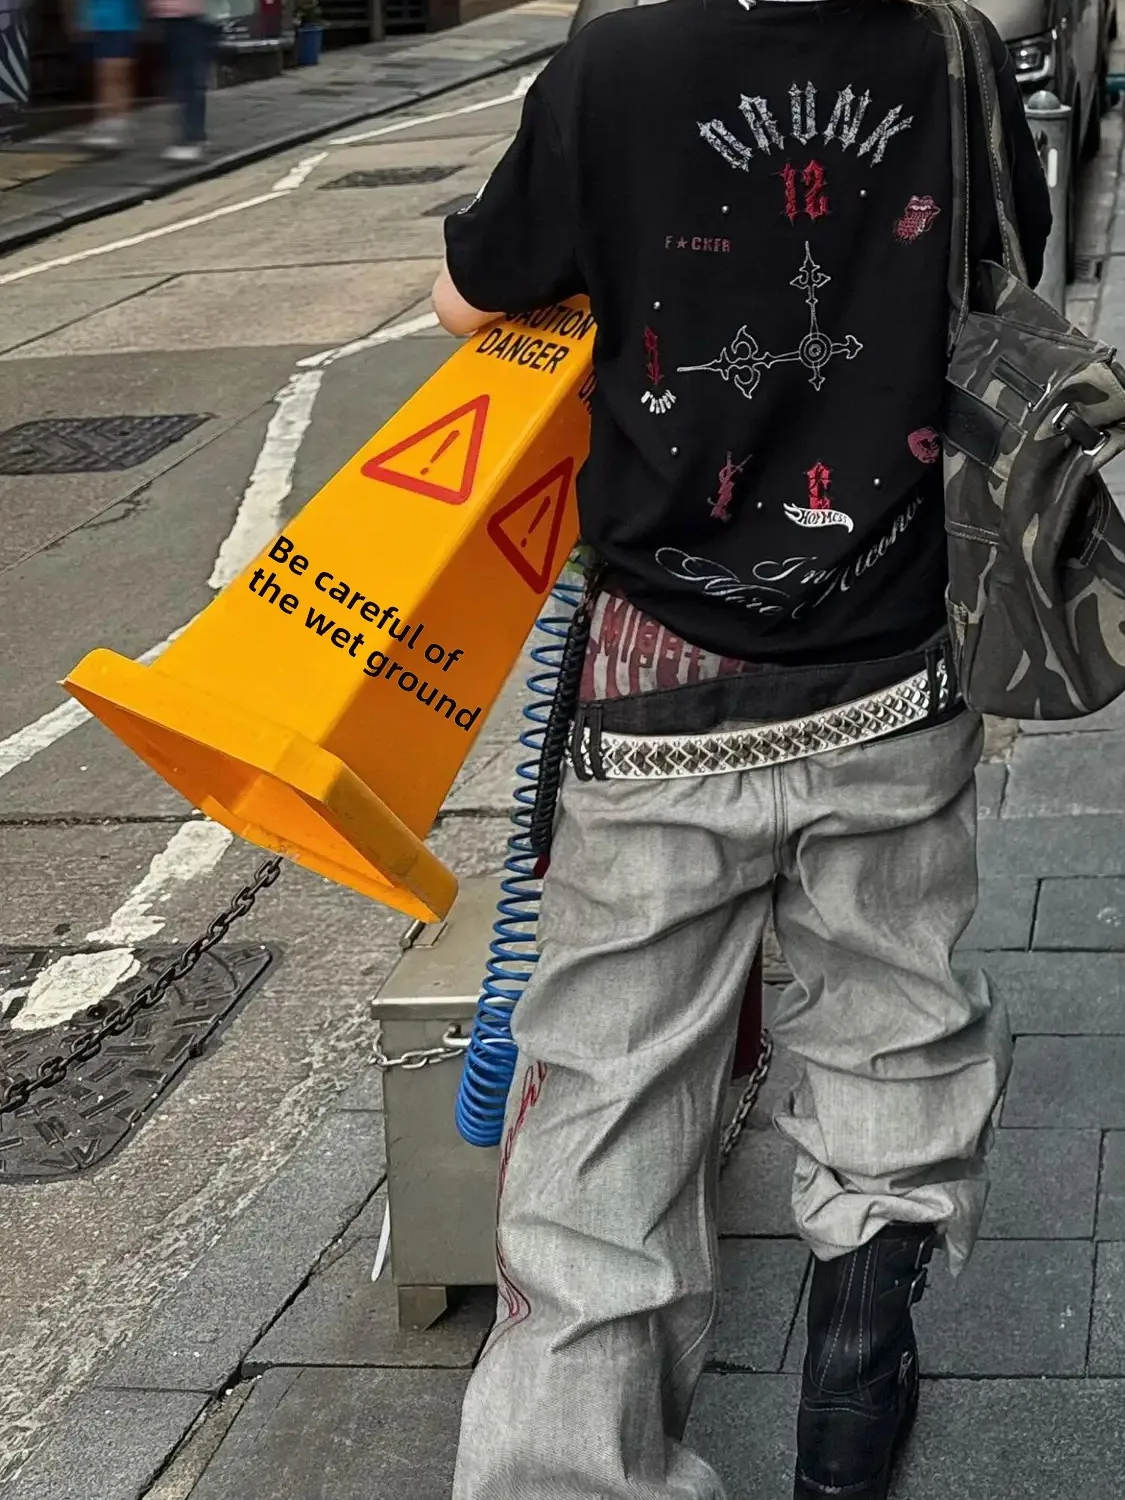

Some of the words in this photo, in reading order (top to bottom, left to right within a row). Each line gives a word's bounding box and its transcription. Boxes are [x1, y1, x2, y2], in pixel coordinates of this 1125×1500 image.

[476, 327, 570, 375] DANGER
[248, 568, 299, 615] the
[304, 607, 365, 658] wet
[362, 650, 482, 732] ground
[268, 535, 309, 576] Be
[314, 571, 424, 650] careful
[424, 643, 464, 672] of
